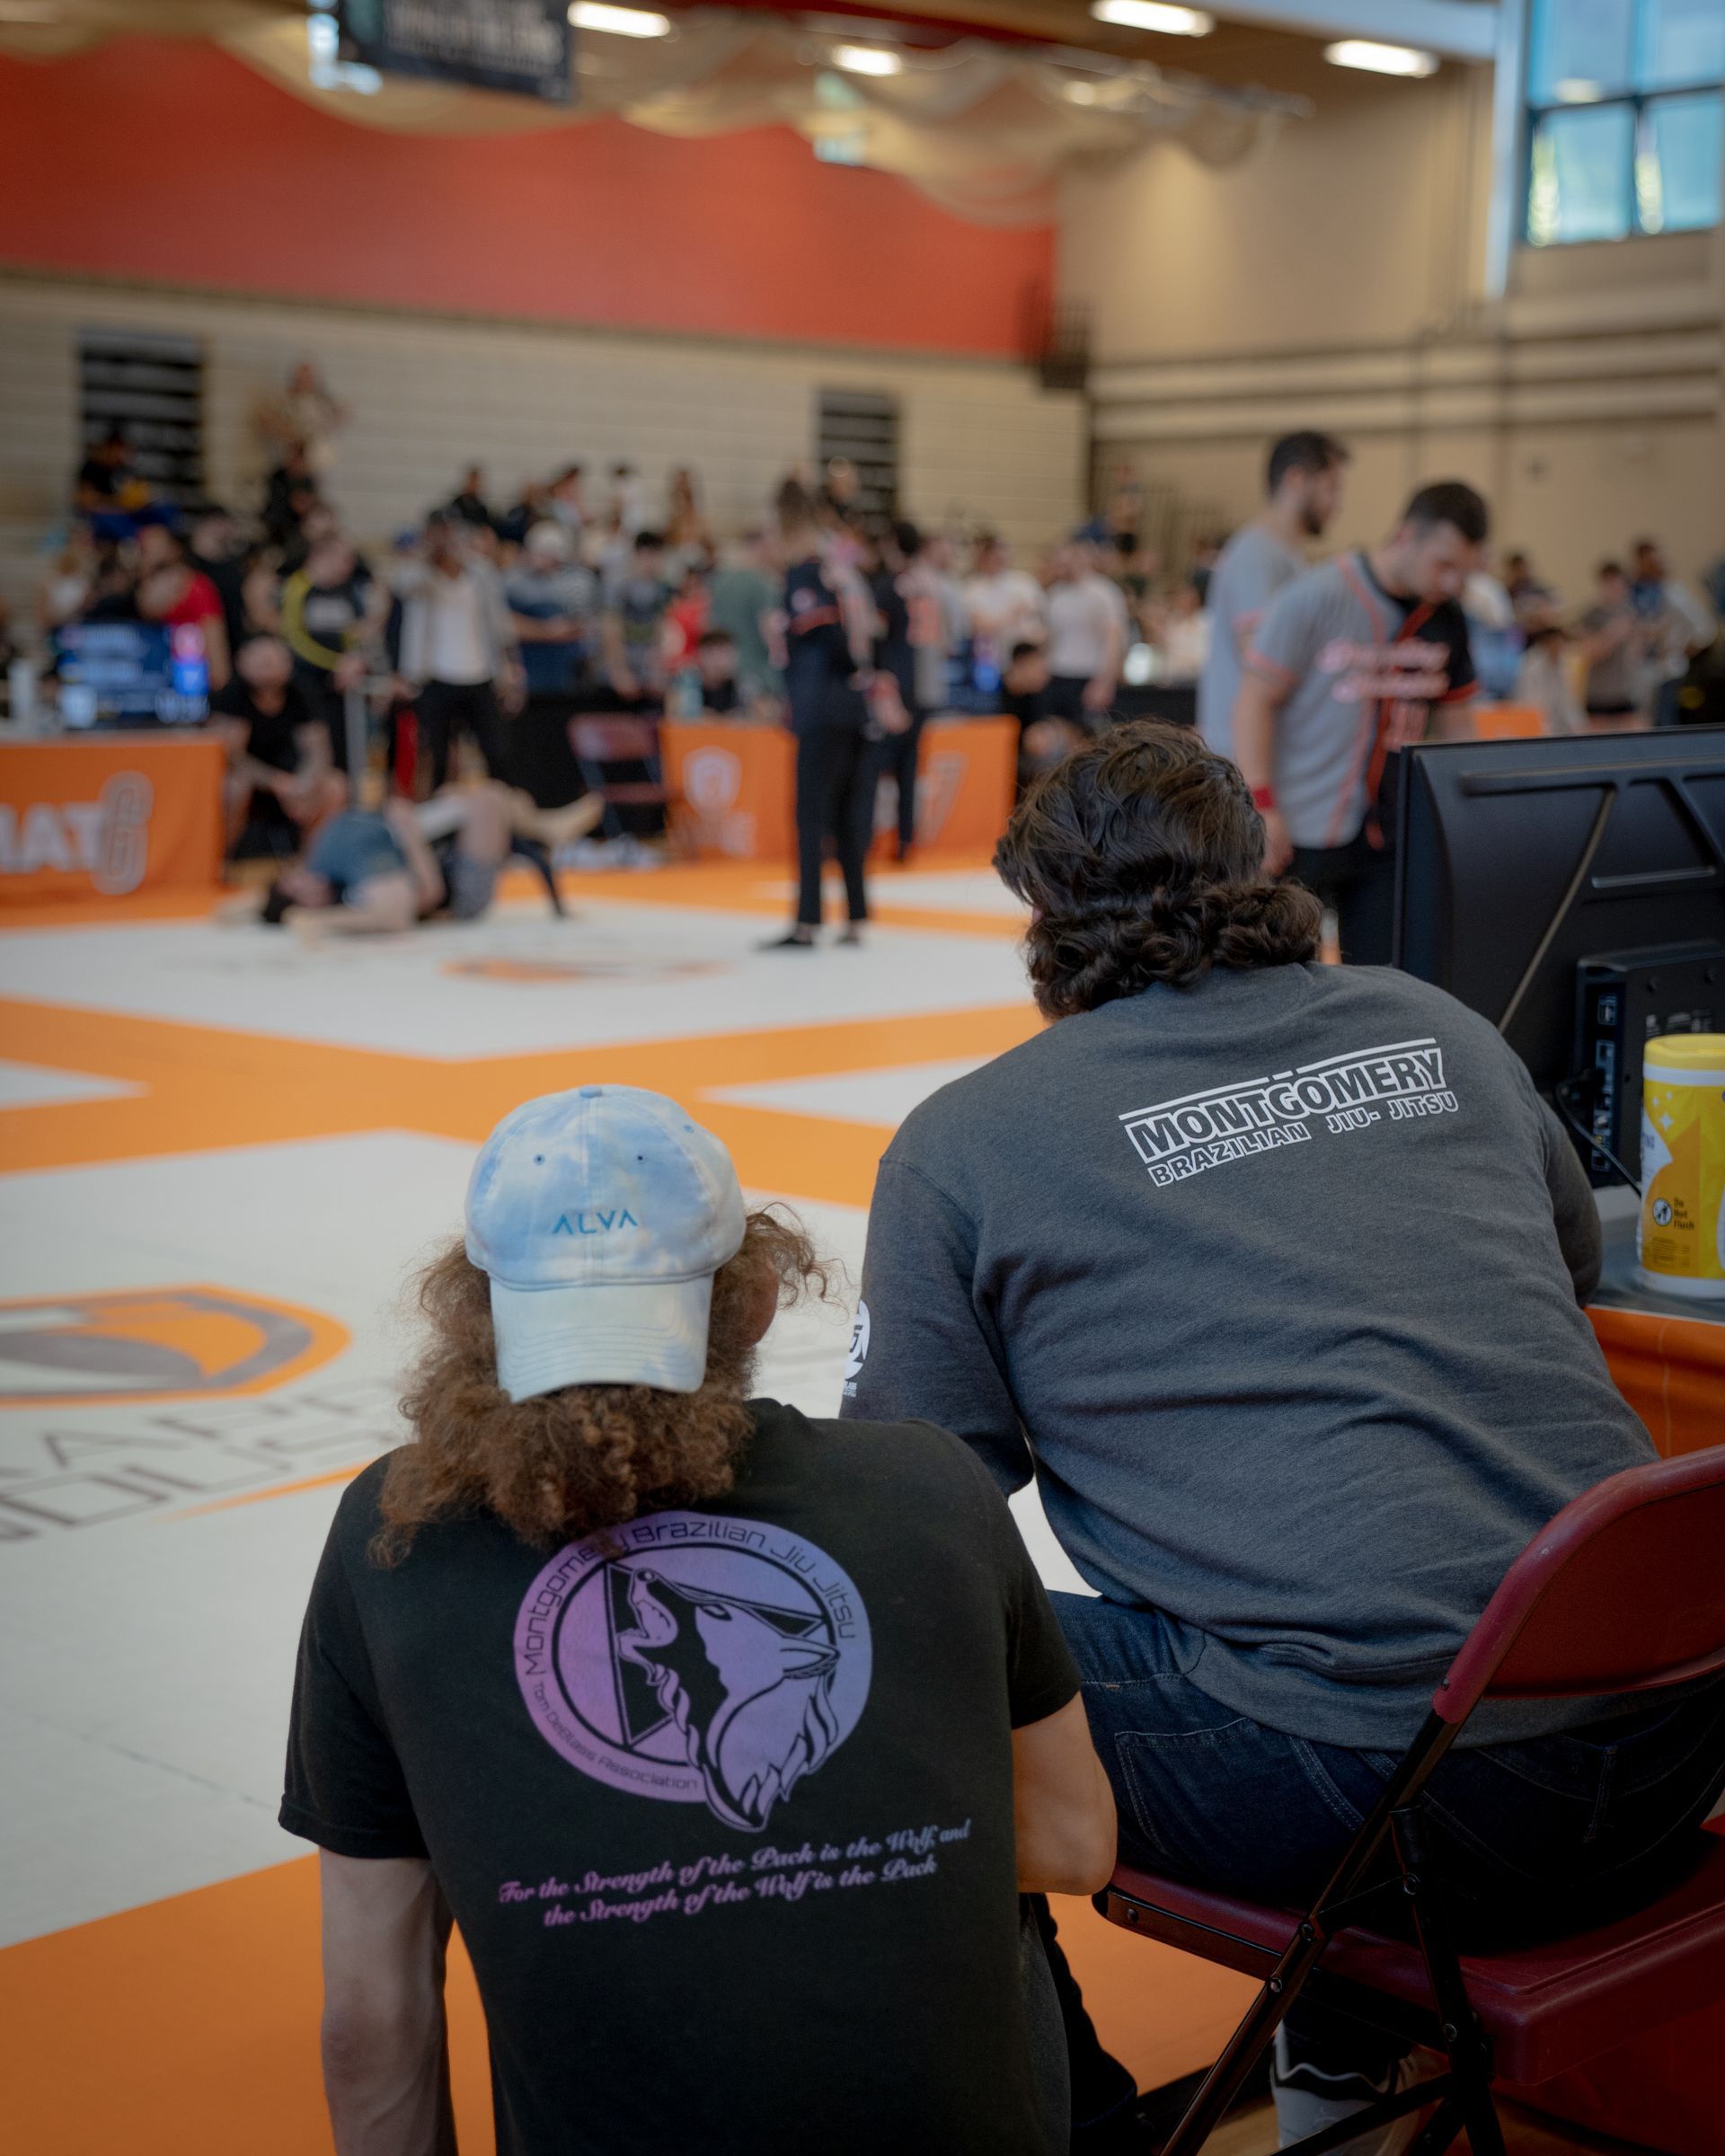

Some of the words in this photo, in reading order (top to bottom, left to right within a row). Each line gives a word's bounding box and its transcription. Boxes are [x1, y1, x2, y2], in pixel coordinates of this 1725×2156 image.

[1124, 1047, 1446, 1164] MONTGOMERY
[1147, 1122, 1312, 1187] BRAZILIAN
[1389, 1091, 1459, 1121] JITSU
[552, 1208, 639, 1235] ALVA
[1674, 1209, 1688, 1219] Not
[1674, 1221, 1694, 1231] Flush
[524, 1533, 631, 1675] Montgomey
[632, 1520, 766, 1549] Brazilian
[769, 1545, 817, 1574] Jiu
[812, 1577, 856, 1639] Jitsu
[597, 1756, 698, 1790] Association
[499, 1881, 536, 1903] For
[539, 1877, 570, 1899] the
[574, 1860, 676, 1895] Strength
[679, 1855, 712, 1886] of
[708, 1853, 746, 1877] the
[750, 1842, 816, 1871] Pack
[819, 1843, 842, 1862] is
[845, 1836, 882, 1860] the
[939, 1817, 972, 1842] and
[544, 1904, 577, 1927] the
[580, 1888, 679, 1922] Strength
[684, 1883, 717, 1915] of
[713, 1880, 751, 1903] the
[754, 1870, 817, 1903] Wolf
[813, 1870, 835, 1890] is
[838, 1864, 877, 1887] the
[880, 1852, 938, 1882] Pack
